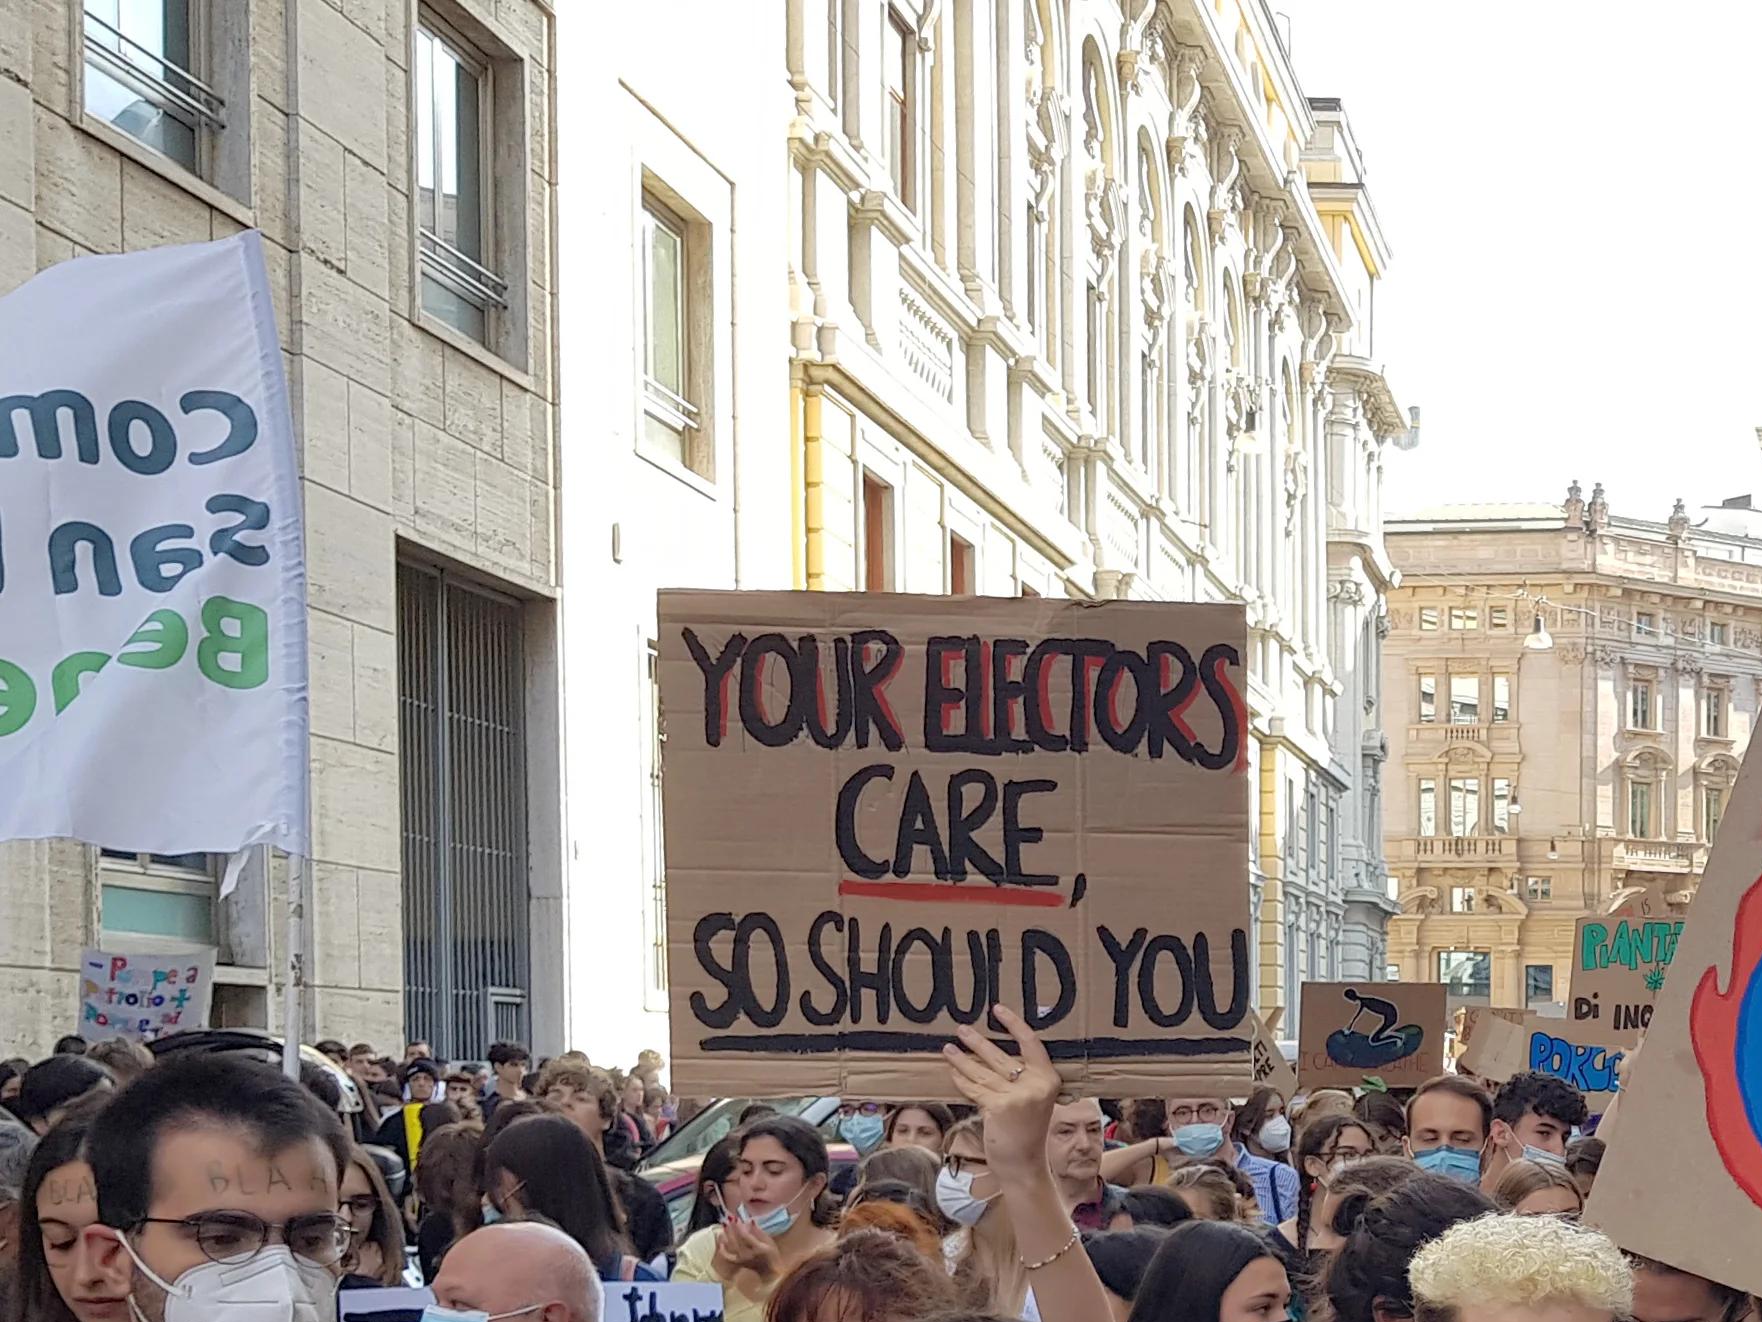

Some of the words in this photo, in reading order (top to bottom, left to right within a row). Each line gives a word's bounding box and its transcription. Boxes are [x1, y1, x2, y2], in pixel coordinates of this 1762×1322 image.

[681, 627, 906, 749] YOUR
[922, 633, 1248, 774] ELECTORS
[835, 764, 1087, 909] CARE,
[689, 911, 791, 1028] SO
[799, 909, 1078, 1032] SHOULD
[1095, 925, 1250, 1030] YOU
[207, 1159, 328, 1196] BLAH
